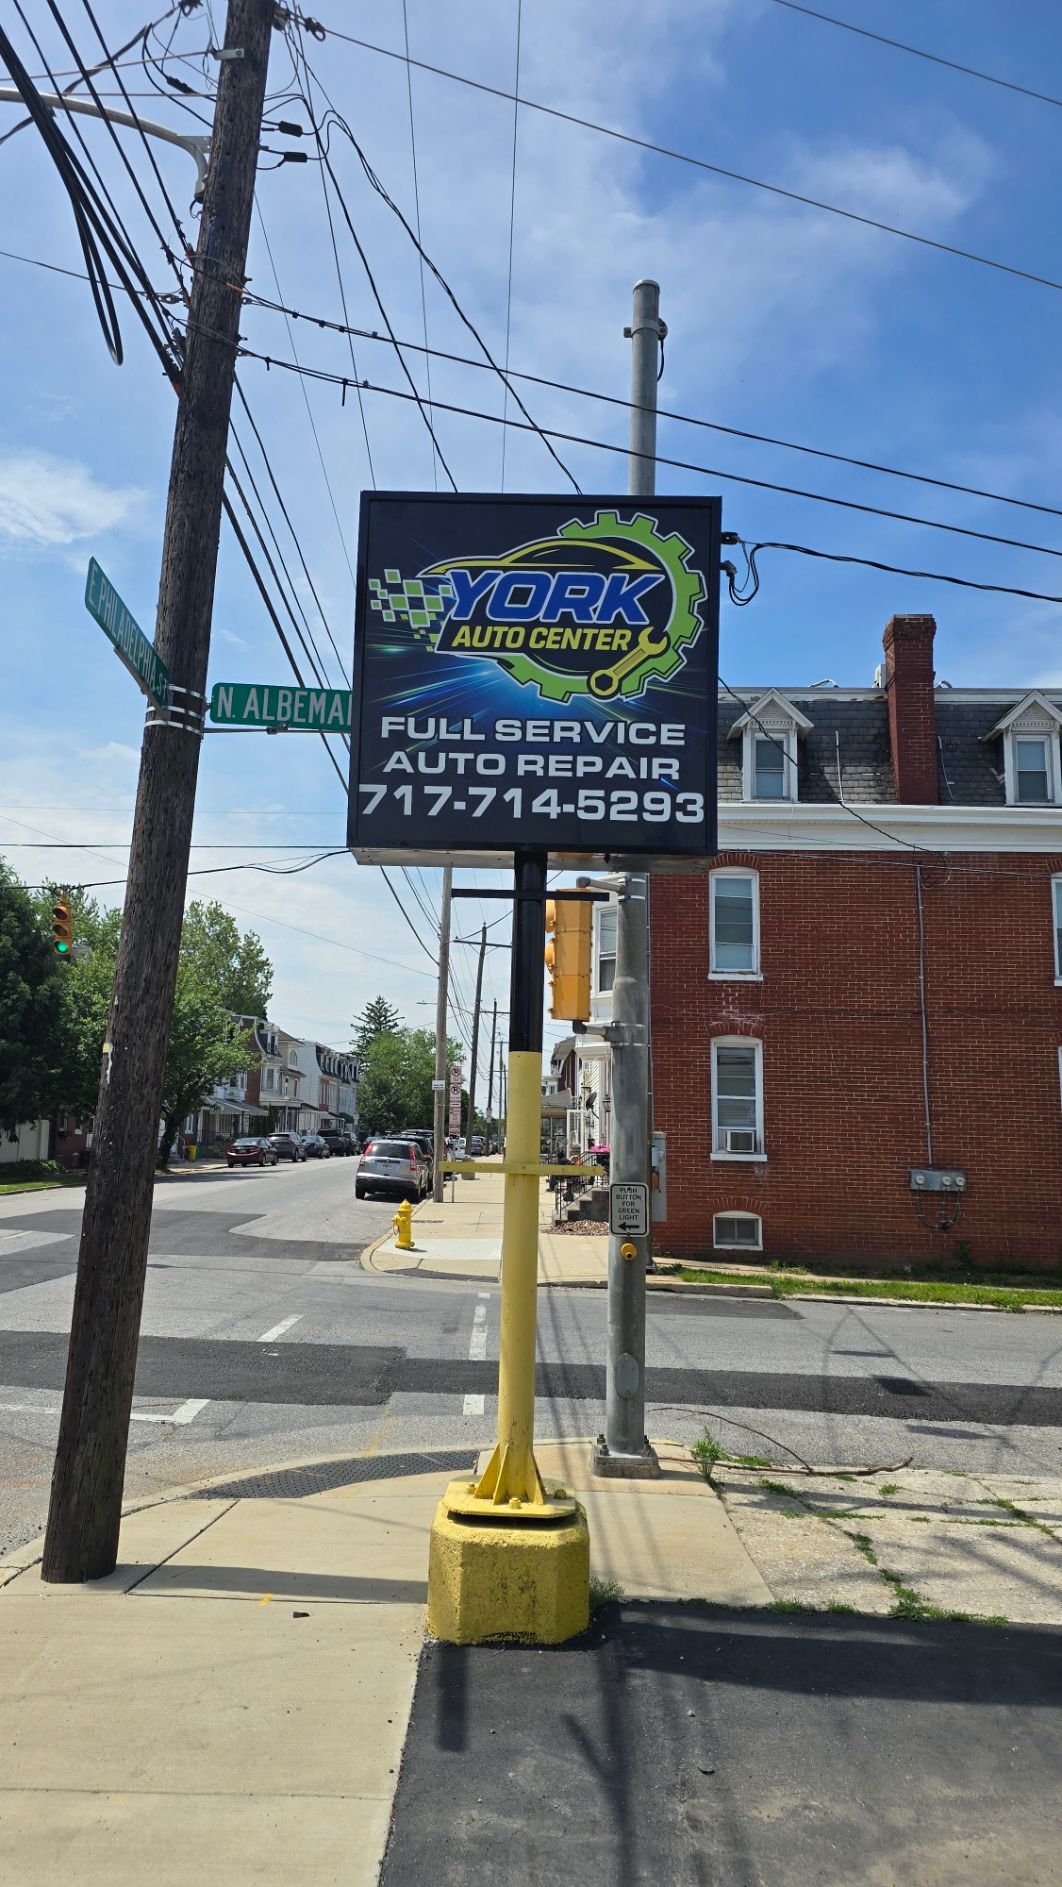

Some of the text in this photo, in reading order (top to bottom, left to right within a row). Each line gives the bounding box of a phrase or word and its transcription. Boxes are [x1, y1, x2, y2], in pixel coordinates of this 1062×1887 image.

[450, 570, 665, 625] YORK
[98, 577, 157, 692] PHILADELPHIA
[452, 625, 632, 652] AUTO CENTER
[217, 686, 352, 725] N. ALBEMA
[381, 717, 686, 745] FULL SERVICE
[383, 751, 680, 780] AUTO REPAIR
[359, 784, 705, 823] 717-714-5293
